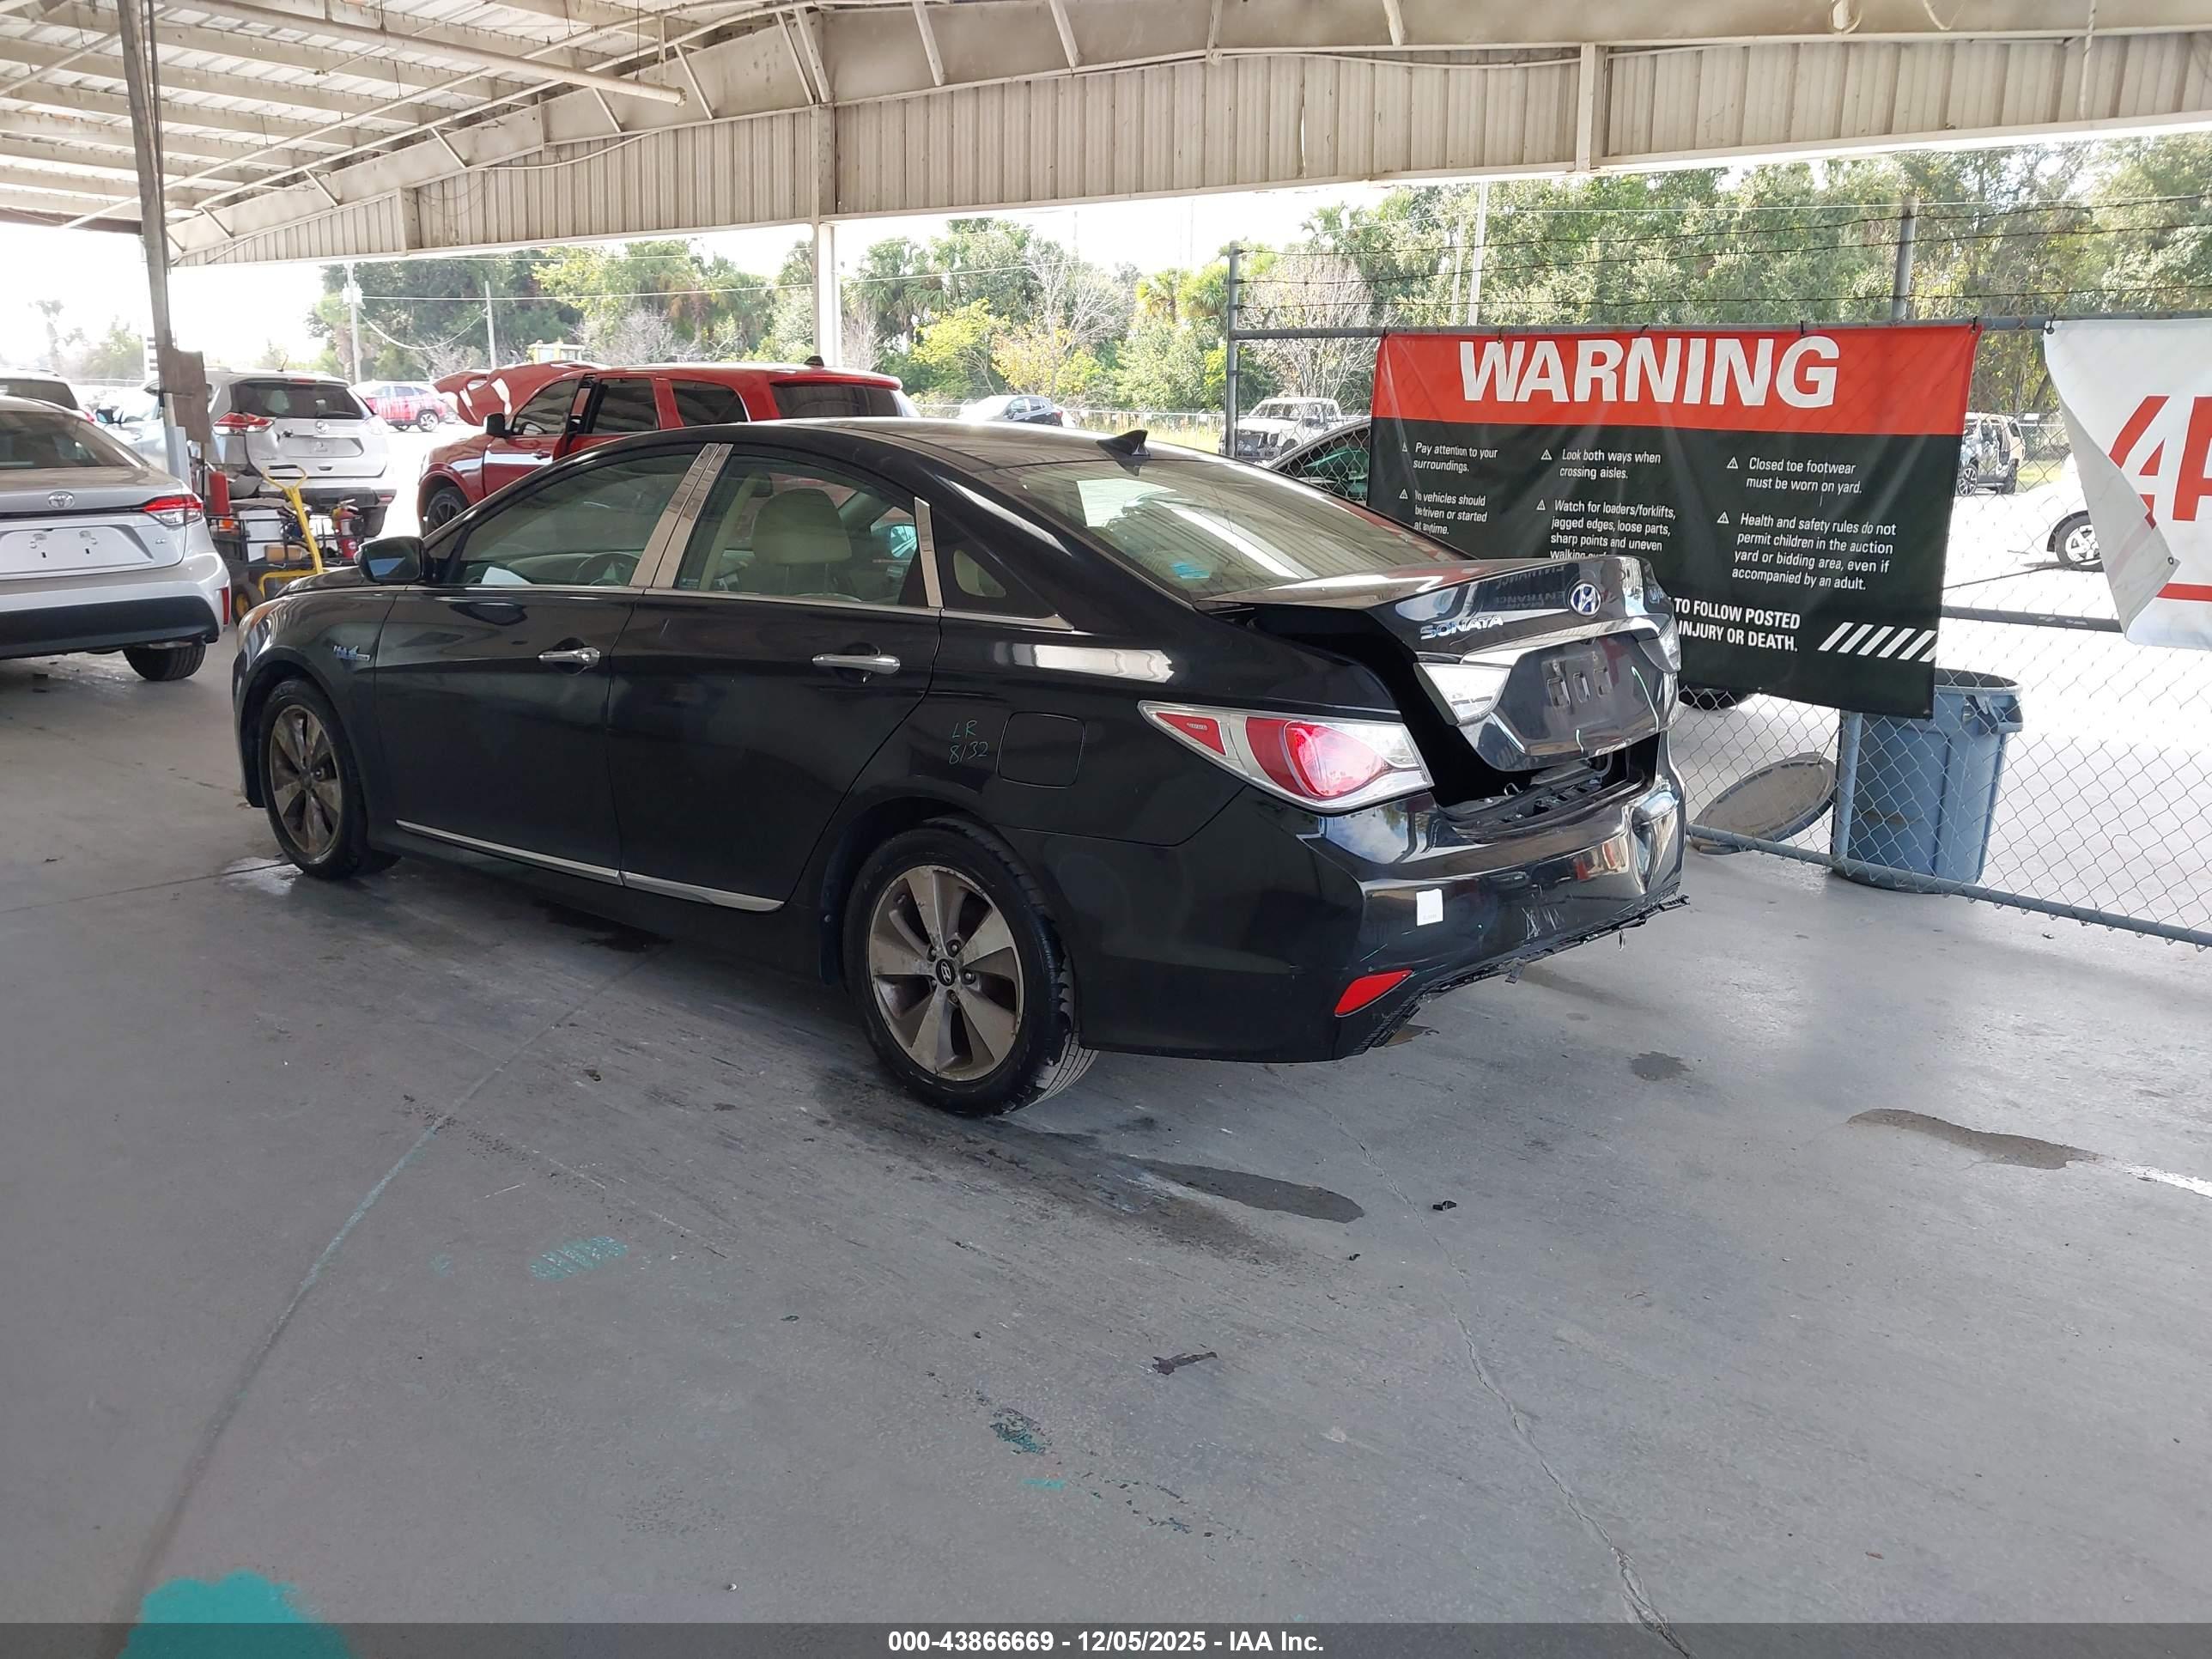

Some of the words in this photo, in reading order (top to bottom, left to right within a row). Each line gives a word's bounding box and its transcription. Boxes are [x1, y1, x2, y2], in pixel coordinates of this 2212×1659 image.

[1460, 336, 1839, 409] WARNING
[1415, 442, 1432, 456] Pay
[1434, 445, 1468, 457] attention
[1468, 447, 1478, 458] to
[1480, 448, 1498, 460] your
[1562, 448, 1581, 460] Look
[1583, 449, 1605, 461] both
[1607, 451, 1632, 465] ways
[1634, 451, 1662, 464] when
[1413, 459, 1469, 474] surroundings.
[1559, 465, 1596, 480] crossing
[1600, 466, 1629, 479] aisles.
[1748, 457, 1784, 471] Closed
[1786, 459, 1803, 472] toe
[1807, 460, 1856, 474] footwear
[1746, 477, 1773, 489] must
[1775, 477, 1789, 490] be
[1790, 481, 1819, 491] worn
[1821, 481, 1834, 492] on
[1837, 481, 1863, 495] yard.
[1423, 491, 1457, 504] vehicles
[1458, 494, 1486, 507] should
[1414, 504, 1423, 516] be
[1423, 506, 1445, 519] driven
[1446, 511, 1456, 520] or
[1457, 511, 1488, 523] started
[1554, 499, 1585, 513] Watch
[1588, 501, 1601, 513] for
[1602, 502, 1676, 520] loaders/forklifts,
[1413, 521, 1422, 531] at
[1551, 516, 1584, 531] jagged
[1586, 518, 1616, 532] edges,
[1617, 520, 1643, 532] loose
[1644, 523, 1671, 537] parts,
[1741, 513, 1775, 528] Health
[1776, 515, 1797, 530] and
[1798, 517, 1831, 534] safety
[1832, 520, 1859, 533] rules
[1861, 521, 1874, 534] do
[1875, 524, 1897, 536] not
[1551, 532, 1578, 545] sharp
[1580, 534, 1608, 547] points
[1610, 537, 1626, 549] and
[1628, 540, 1662, 551] uneven
[1737, 533, 1771, 546] permit
[1773, 534, 1814, 550] children
[1816, 537, 1826, 550] in
[1829, 538, 1847, 551] the
[1850, 541, 1893, 555] auction
[1735, 550, 1759, 563] yard
[1761, 552, 1775, 563] or
[1776, 552, 1815, 569] bidding
[1818, 557, 1844, 572] area,
[1847, 561, 1877, 573] even
[1881, 559, 1889, 574] if
[1732, 568, 1802, 584] accompanied
[1803, 572, 1817, 588] by
[1819, 577, 1832, 587] an
[1833, 577, 1866, 591] adult.
[1674, 598, 1691, 614] TO
[1693, 600, 1743, 622] FOLLOW
[1745, 608, 1801, 630] POSTED
[1420, 615, 1504, 641] SONATA
[1678, 621, 1724, 641] INJURY
[1727, 628, 1745, 645] OR
[1747, 631, 1799, 652] DEATH.
[952, 720, 977, 738] LR
